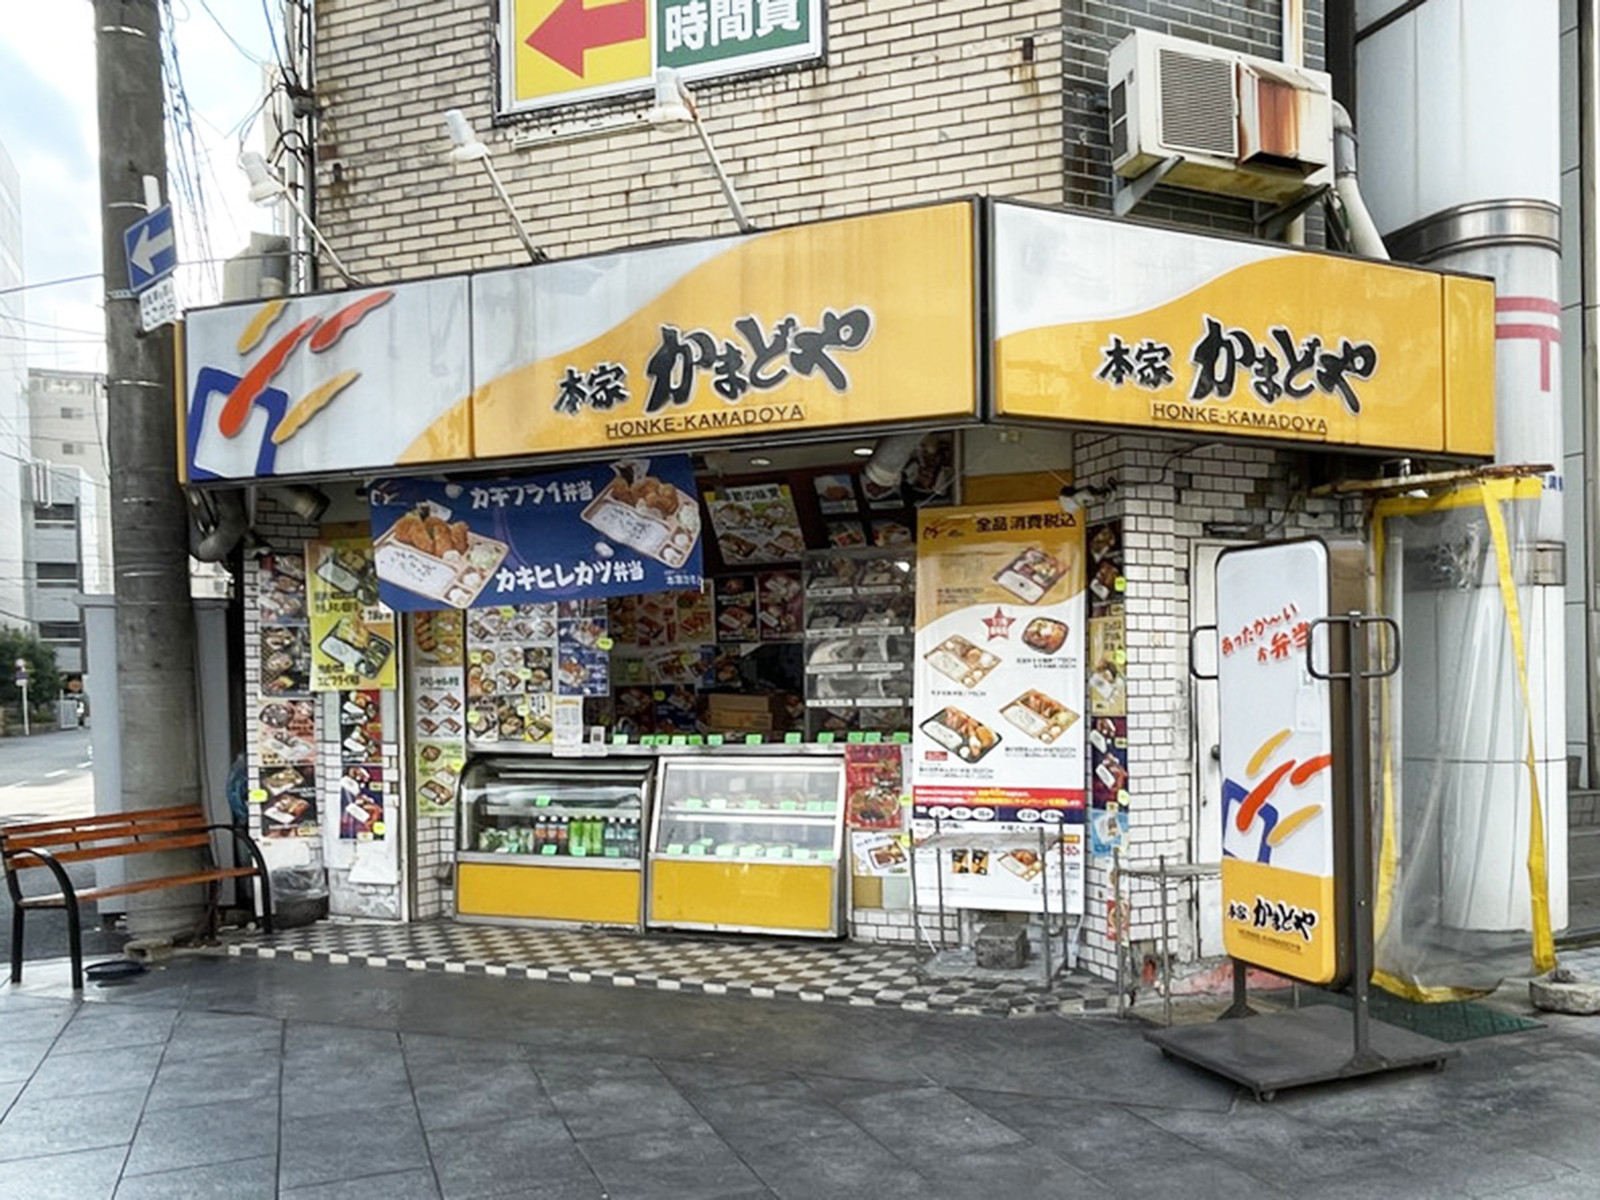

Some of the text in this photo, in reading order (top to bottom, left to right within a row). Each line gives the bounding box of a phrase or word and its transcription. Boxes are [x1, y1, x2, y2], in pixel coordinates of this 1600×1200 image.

[554, 309, 871, 415] 本家 かまどや
[1099, 318, 1377, 414] 本家 かまどや
[606, 404, 805, 438] HONKE-KAMADOYA
[1152, 403, 1328, 432] HONKE-KAMADOYA
[471, 481, 594, 509] カキフライ弁当
[496, 560, 644, 592] カキヒレカツ弁当
[1253, 898, 1316, 941] かまどや
